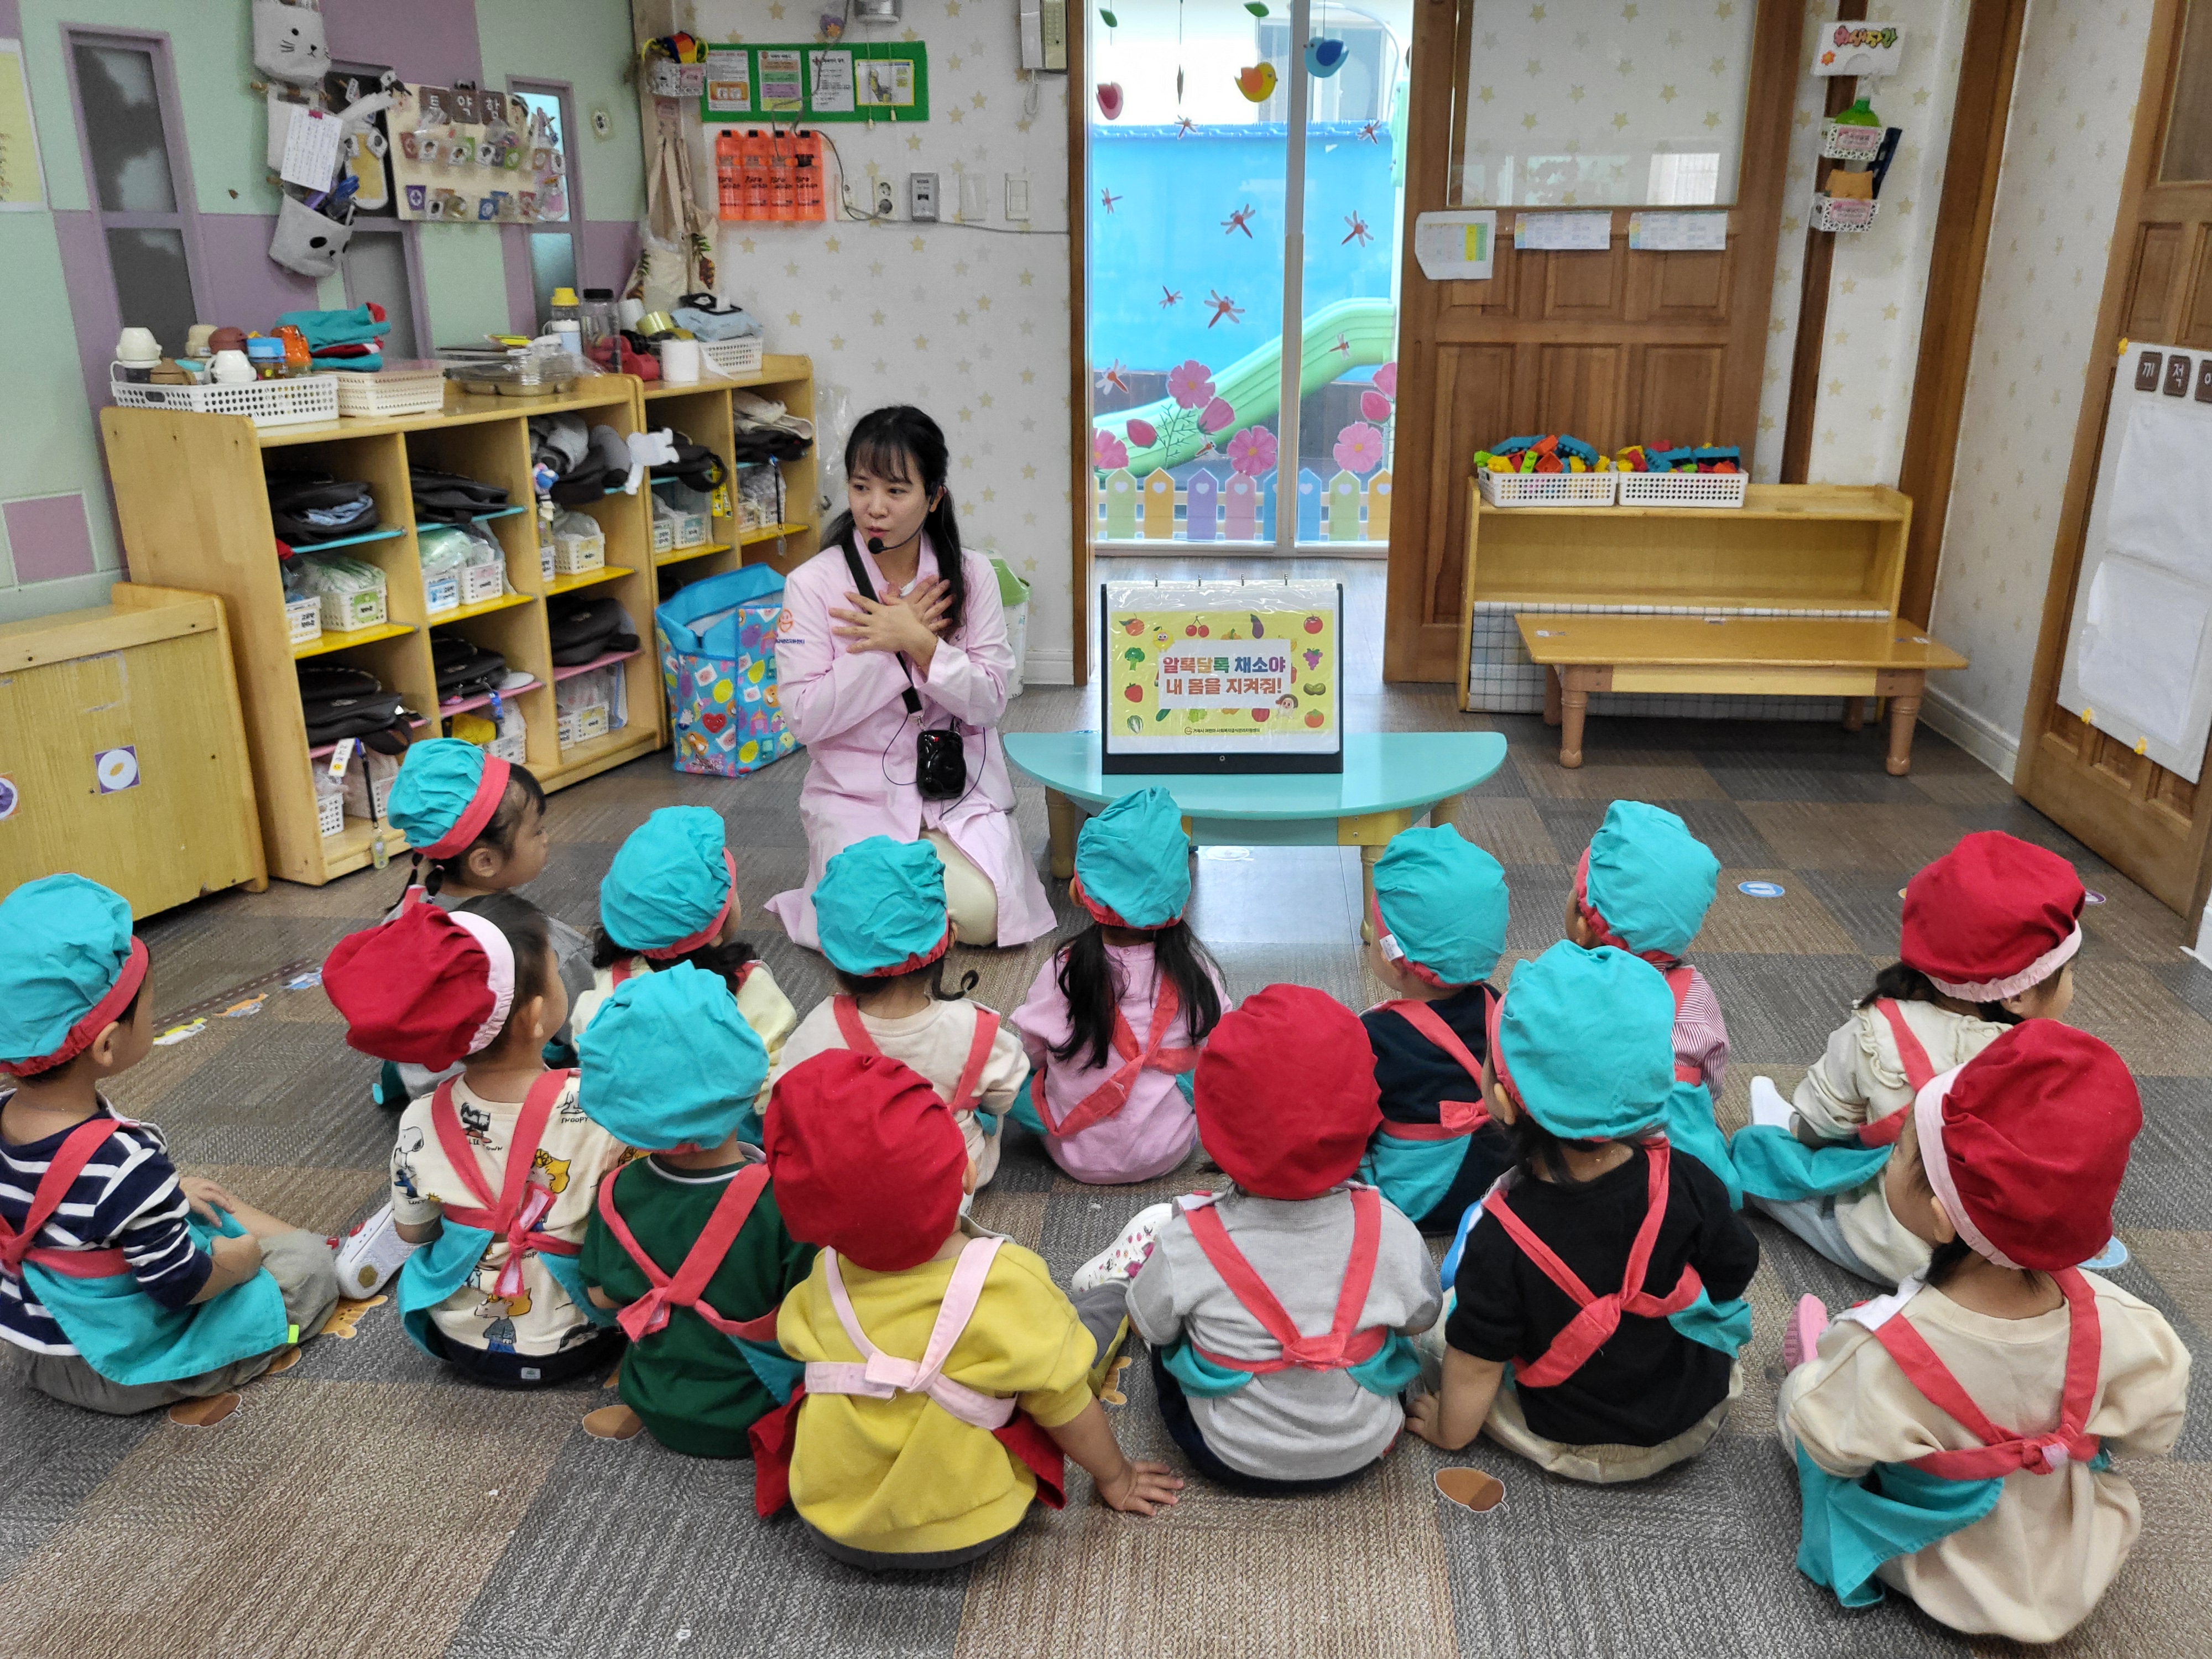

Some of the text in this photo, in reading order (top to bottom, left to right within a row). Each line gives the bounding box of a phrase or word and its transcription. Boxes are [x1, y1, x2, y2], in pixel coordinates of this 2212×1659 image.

[1163, 656, 1286, 674] 알록달록 채소야
[1166, 678, 1281, 695] 내 몸을 지켜줘!
